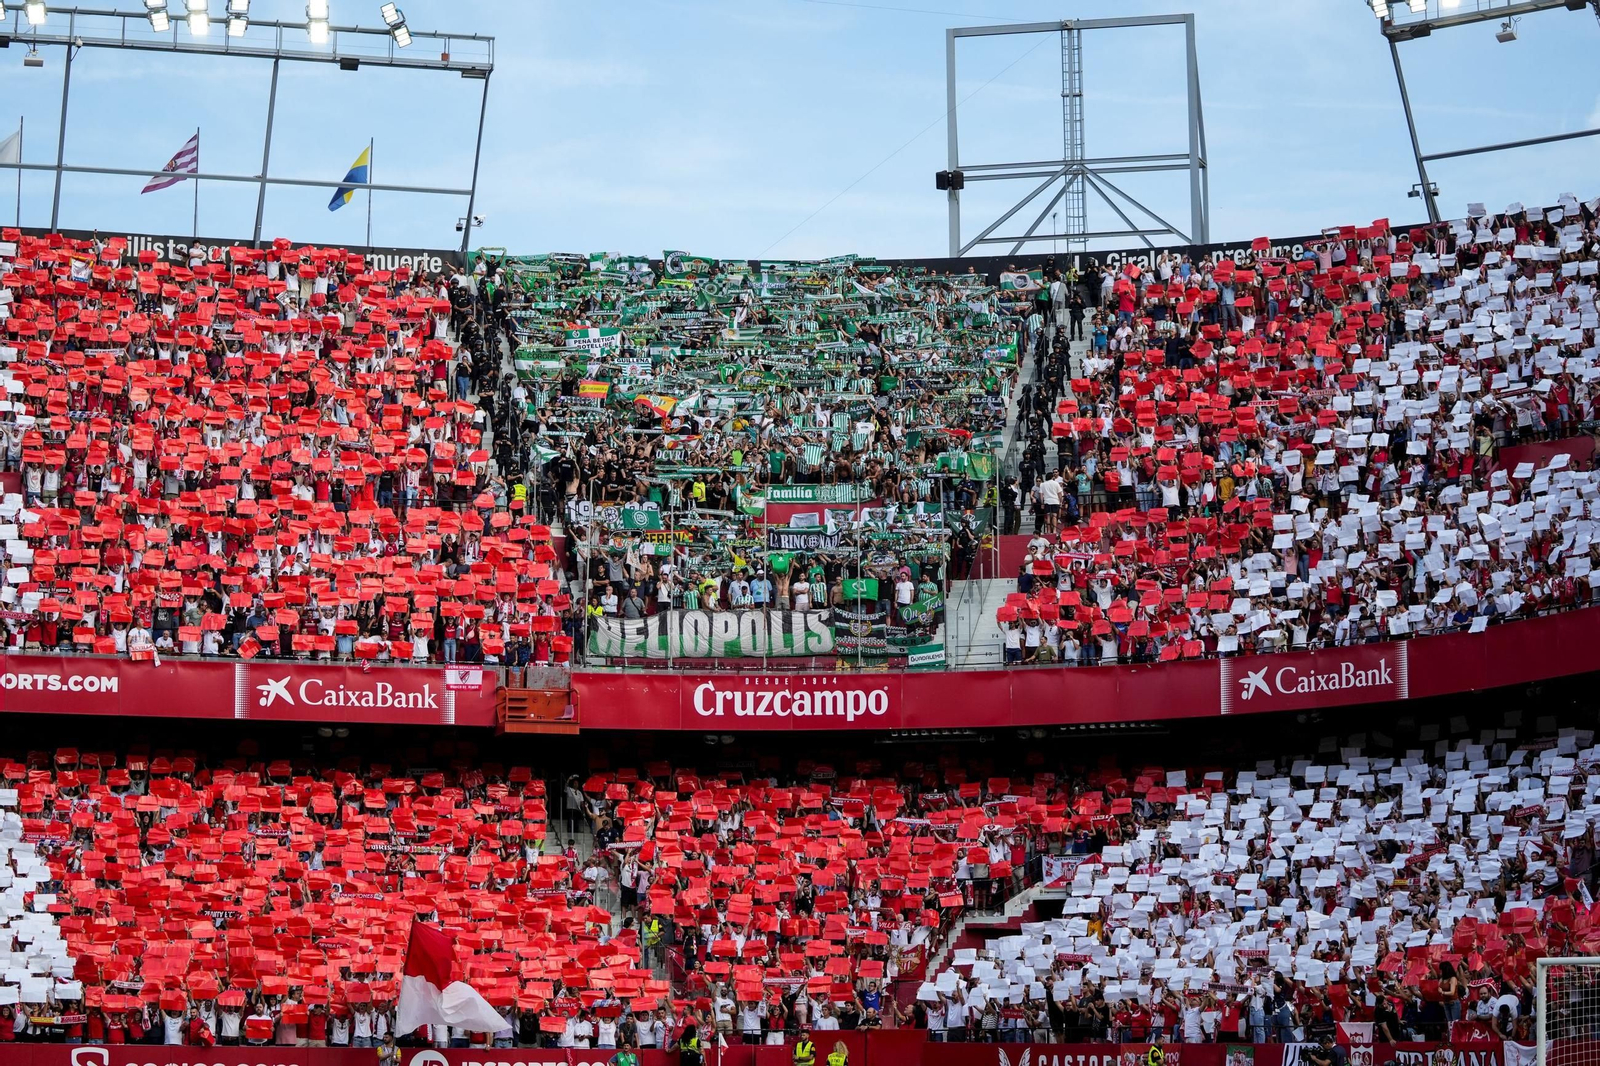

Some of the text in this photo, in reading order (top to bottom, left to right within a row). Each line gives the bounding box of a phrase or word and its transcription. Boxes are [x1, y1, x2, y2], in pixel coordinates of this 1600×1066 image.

[367, 252, 443, 273] muerte
[766, 486, 813, 499] familia
[596, 609, 836, 658] HELIOPOLIS
[745, 677, 838, 686] DESDE 1904
[1275, 658, 1394, 694] CaixaBank
[299, 679, 439, 709] CaixaBank
[693, 680, 889, 722] Cruzcampo
